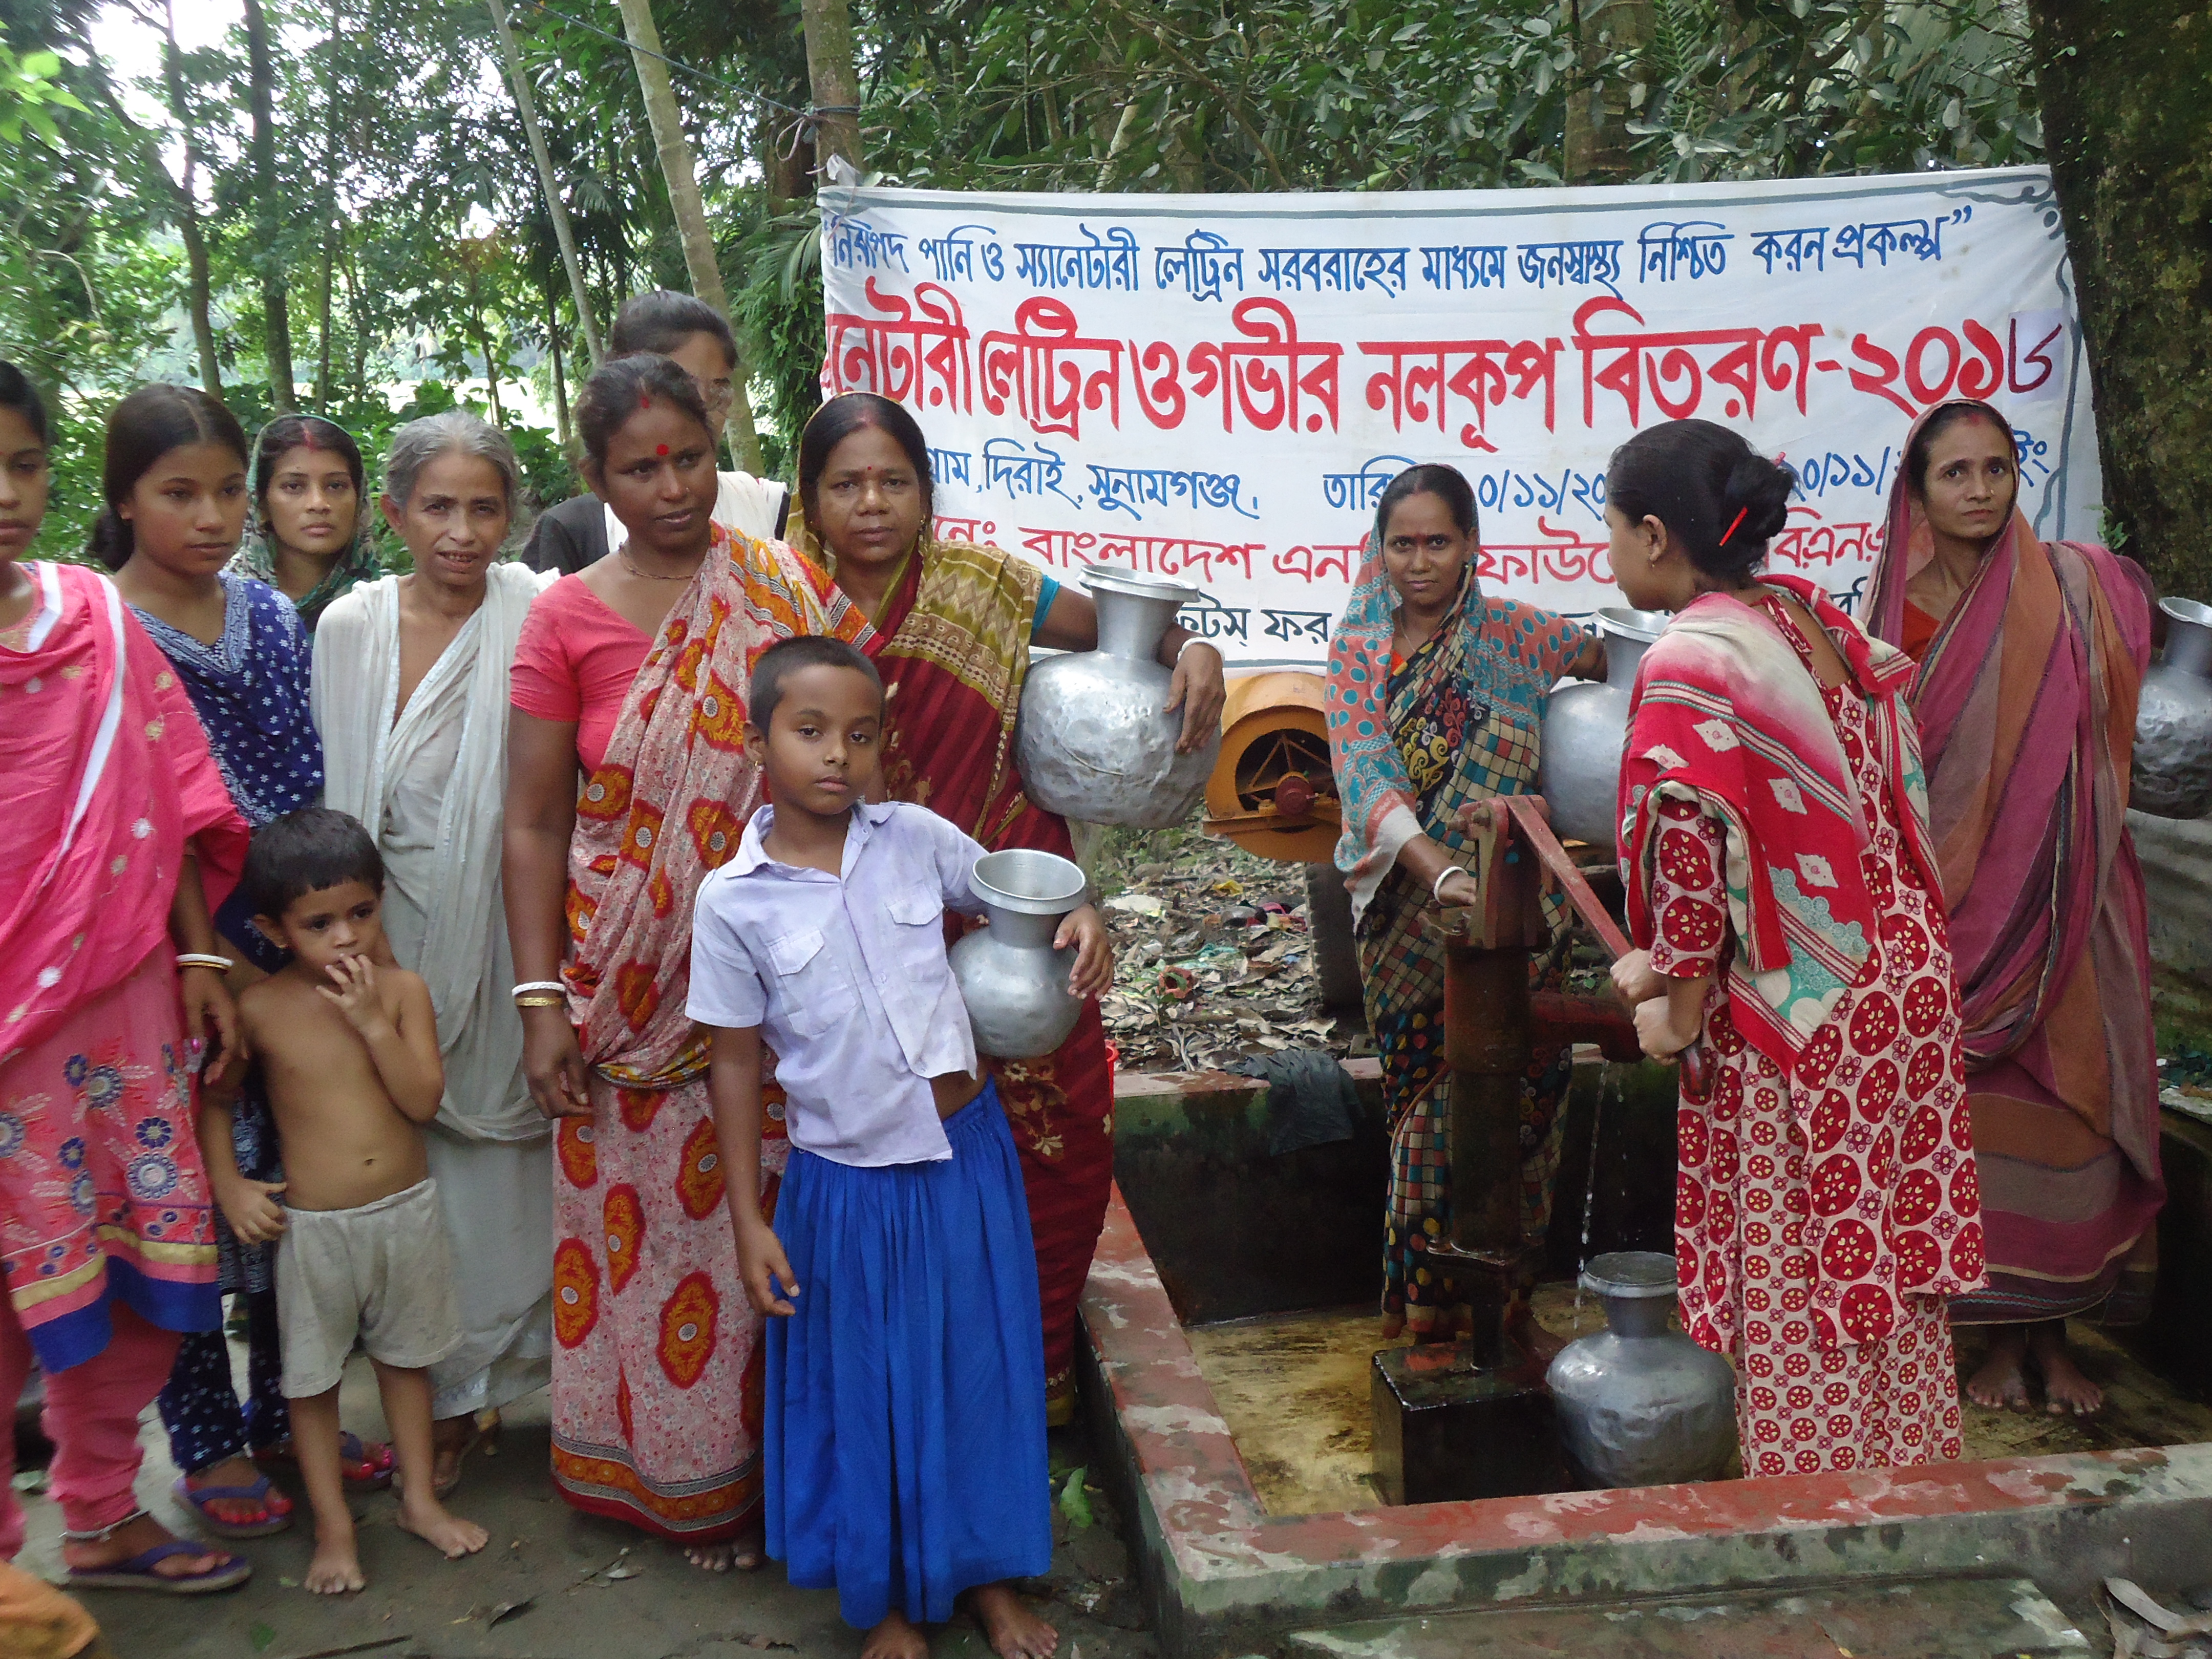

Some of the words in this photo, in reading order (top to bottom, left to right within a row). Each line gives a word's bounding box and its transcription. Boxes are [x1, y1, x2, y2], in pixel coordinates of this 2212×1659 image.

[918, 225, 996, 282] পানি
[981, 241, 1004, 282] ও
[1013, 223, 1140, 291] স্যানেটারী
[1155, 228, 1244, 303] লেট্রিন
[1258, 247, 1411, 299] সরবরাহের
[1419, 245, 1508, 290] মাধ্যমে
[1517, 240, 1624, 301] জনস্বাস্থ্য
[1637, 221, 1735, 284] নিশ্চিত
[1750, 226, 1831, 275] করন
[823, 275, 972, 416] নেটারী
[979, 296, 1125, 442] লেট্রিন
[1129, 339, 1186, 430] ও
[1186, 296, 1345, 435] গভীর
[1356, 337, 1566, 454] নলকূপ
[1017, 526, 1266, 584] বাংলাদেশ
[1260, 609, 1332, 644] ফর
